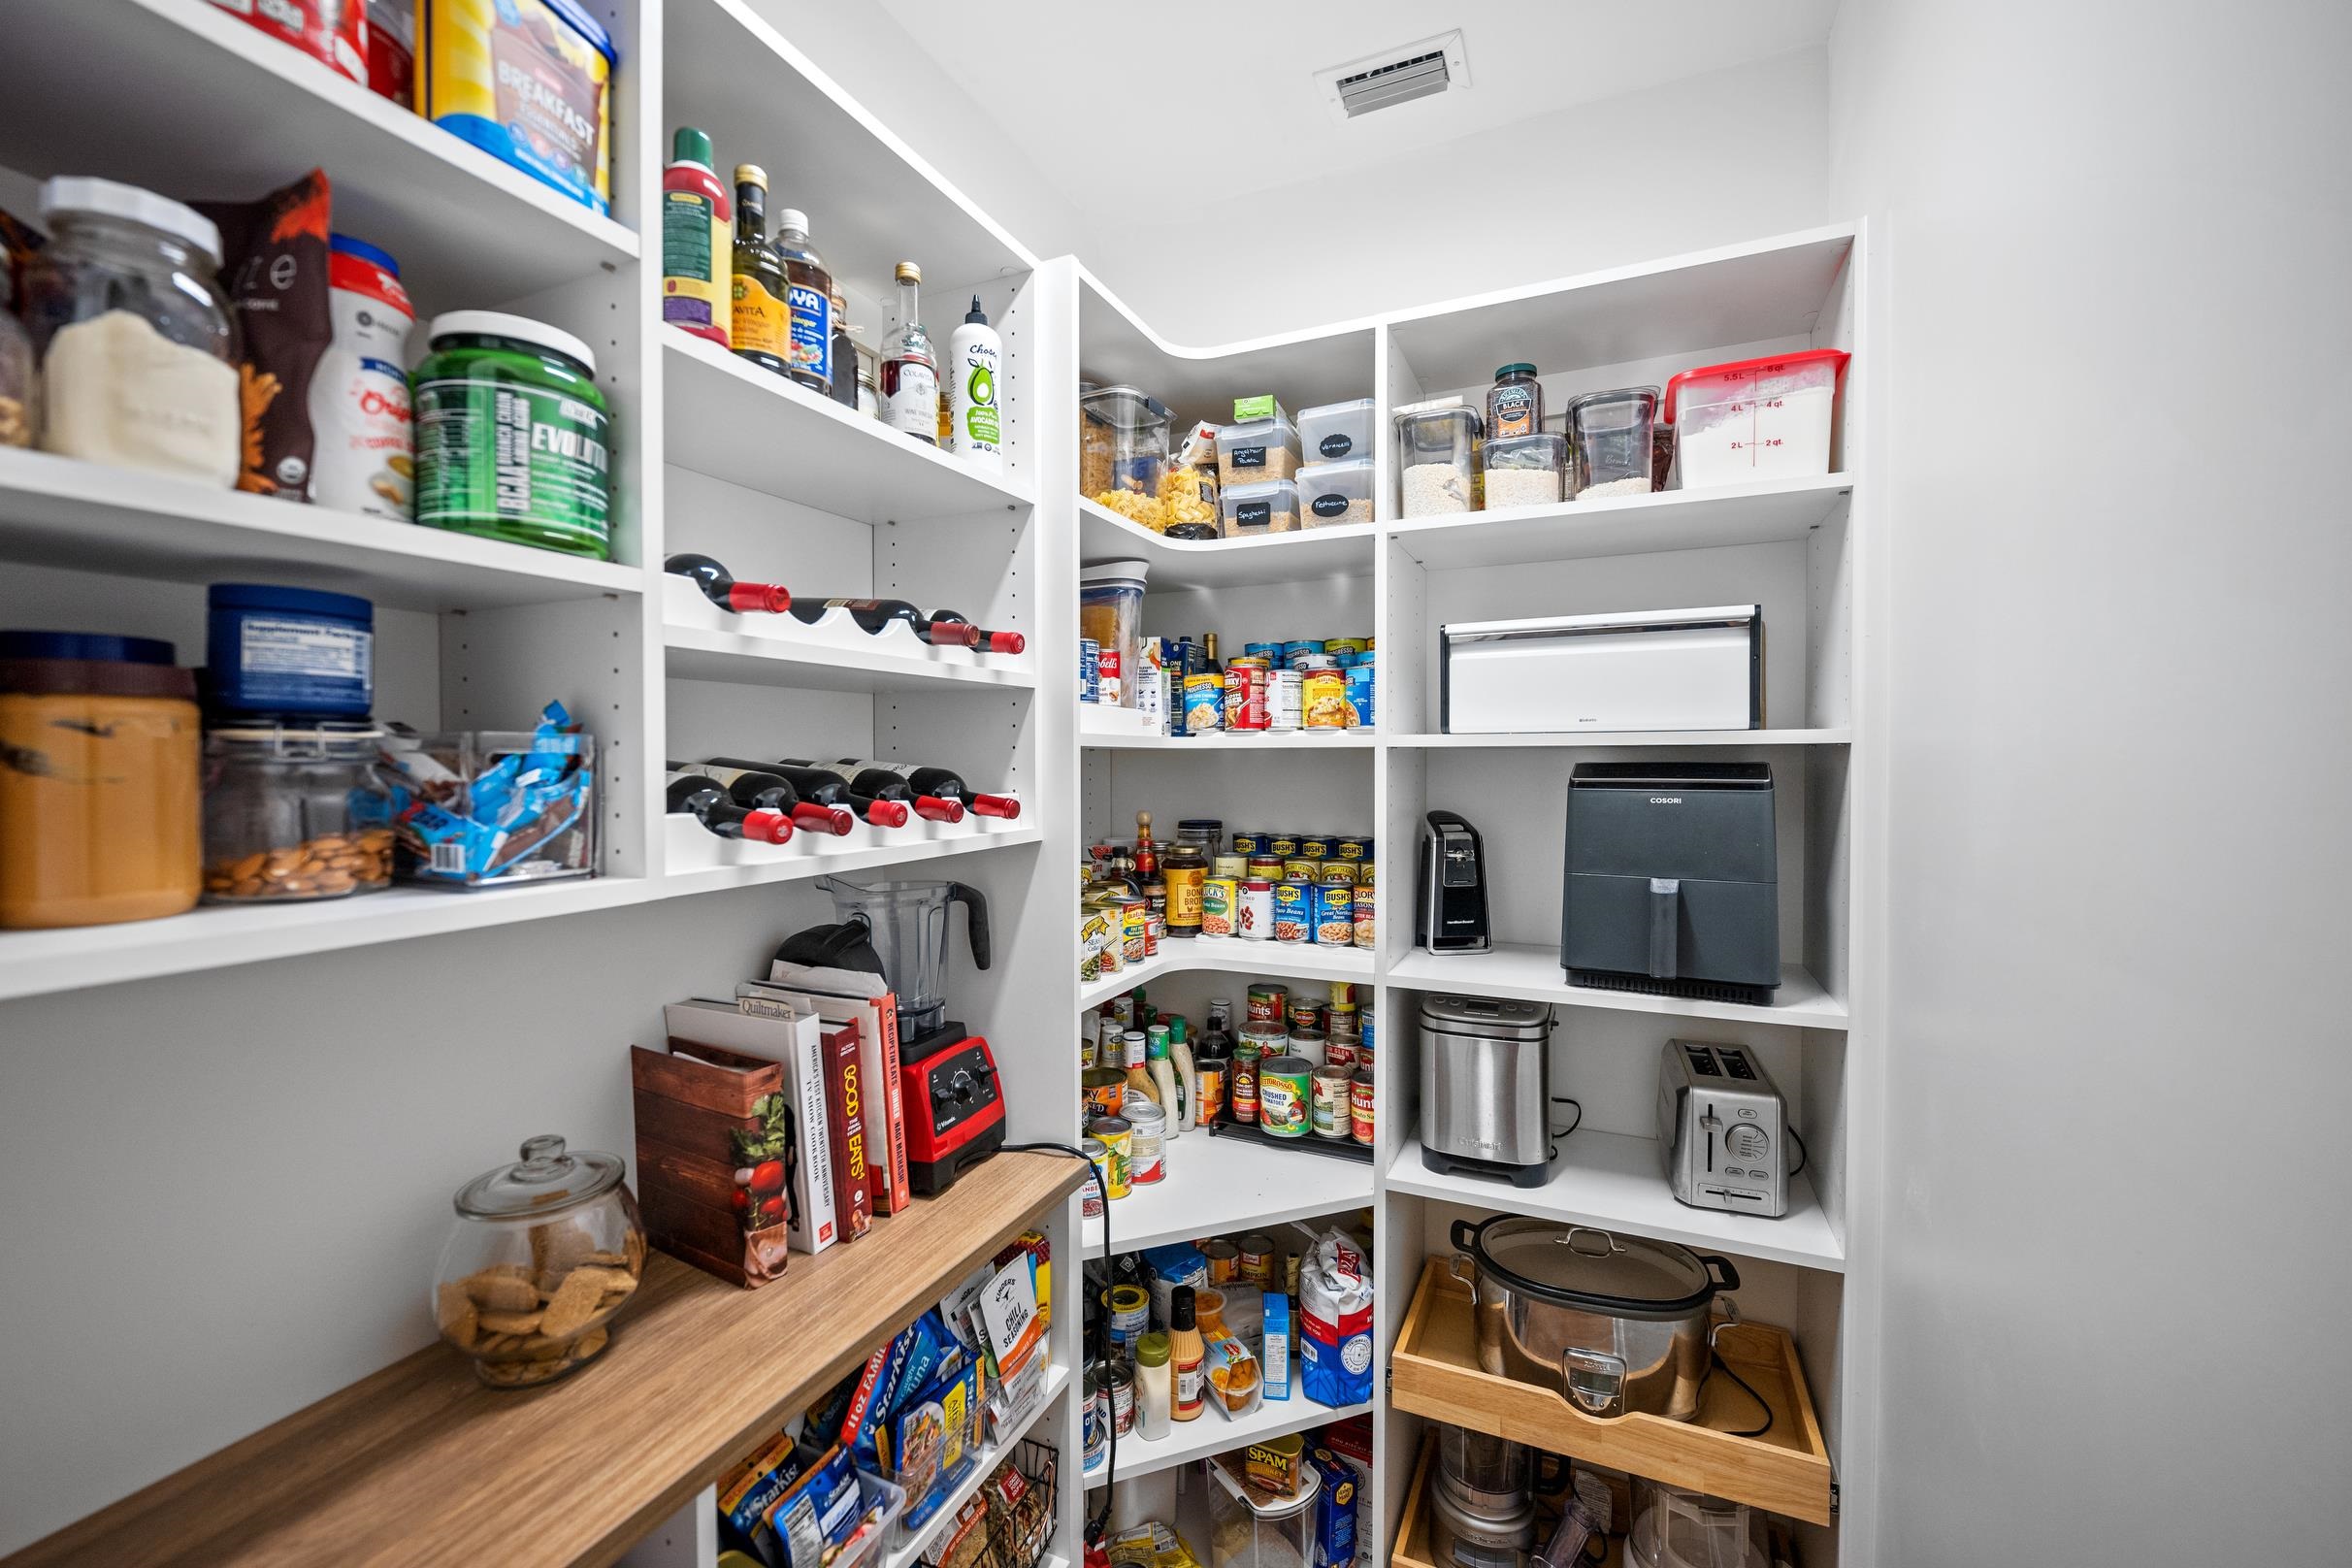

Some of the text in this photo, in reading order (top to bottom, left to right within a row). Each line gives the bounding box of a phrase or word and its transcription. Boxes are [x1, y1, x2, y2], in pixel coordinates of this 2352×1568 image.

[498, 60, 595, 146] BREAKFAST
[733, 307, 765, 318] AVITA
[792, 316, 817, 328] inegar
[1775, 363, 1785, 373] qt.
[1774, 400, 1784, 408] qt.
[496, 466, 531, 512] BCAA
[1234, 841, 1255, 850] BUSH'S
[1272, 843, 1295, 852] BUSH'S
[1203, 887, 1225, 898] UCK'S
[1277, 890, 1300, 898] BUSH'S
[1325, 893, 1351, 901] BUSH'S
[742, 999, 791, 1019] Quiltmaker
[1360, 1062, 1374, 1072] unt
[843, 1063, 860, 1117] GOOD
[1262, 1088, 1288, 1101] CRUSHED
[887, 1022, 905, 1184] RECIPETIN EATS DINNER NAGI MAEHASHI
[1352, 1093, 1374, 1108] Hunt
[815, 1097, 824, 1126] KITCHEN
[849, 1117, 859, 1126] THE
[806, 1079, 812, 1092] TV
[810, 1126, 821, 1182] COOKBOOK
[846, 1126, 862, 1136] YEARS
[847, 1121, 861, 1131] FINAL
[818, 1127, 827, 1163] TWENTIETH
[1458, 1137, 1503, 1152] Cuisinart
[821, 1164, 831, 1208] ANNIVERSARY
[996, 1278, 1016, 1302] KINDER'S
[1005, 1302, 1022, 1332] CHILI
[1002, 1309, 1029, 1348] SEASONING
[856, 1393, 867, 1413] OZ
[863, 1344, 887, 1390] FAMIL
[875, 1323, 916, 1423] StarKist
[907, 1356, 931, 1395] Tuna
[1248, 1446, 1288, 1471] SPAM
[749, 1464, 800, 1512] StarKist
